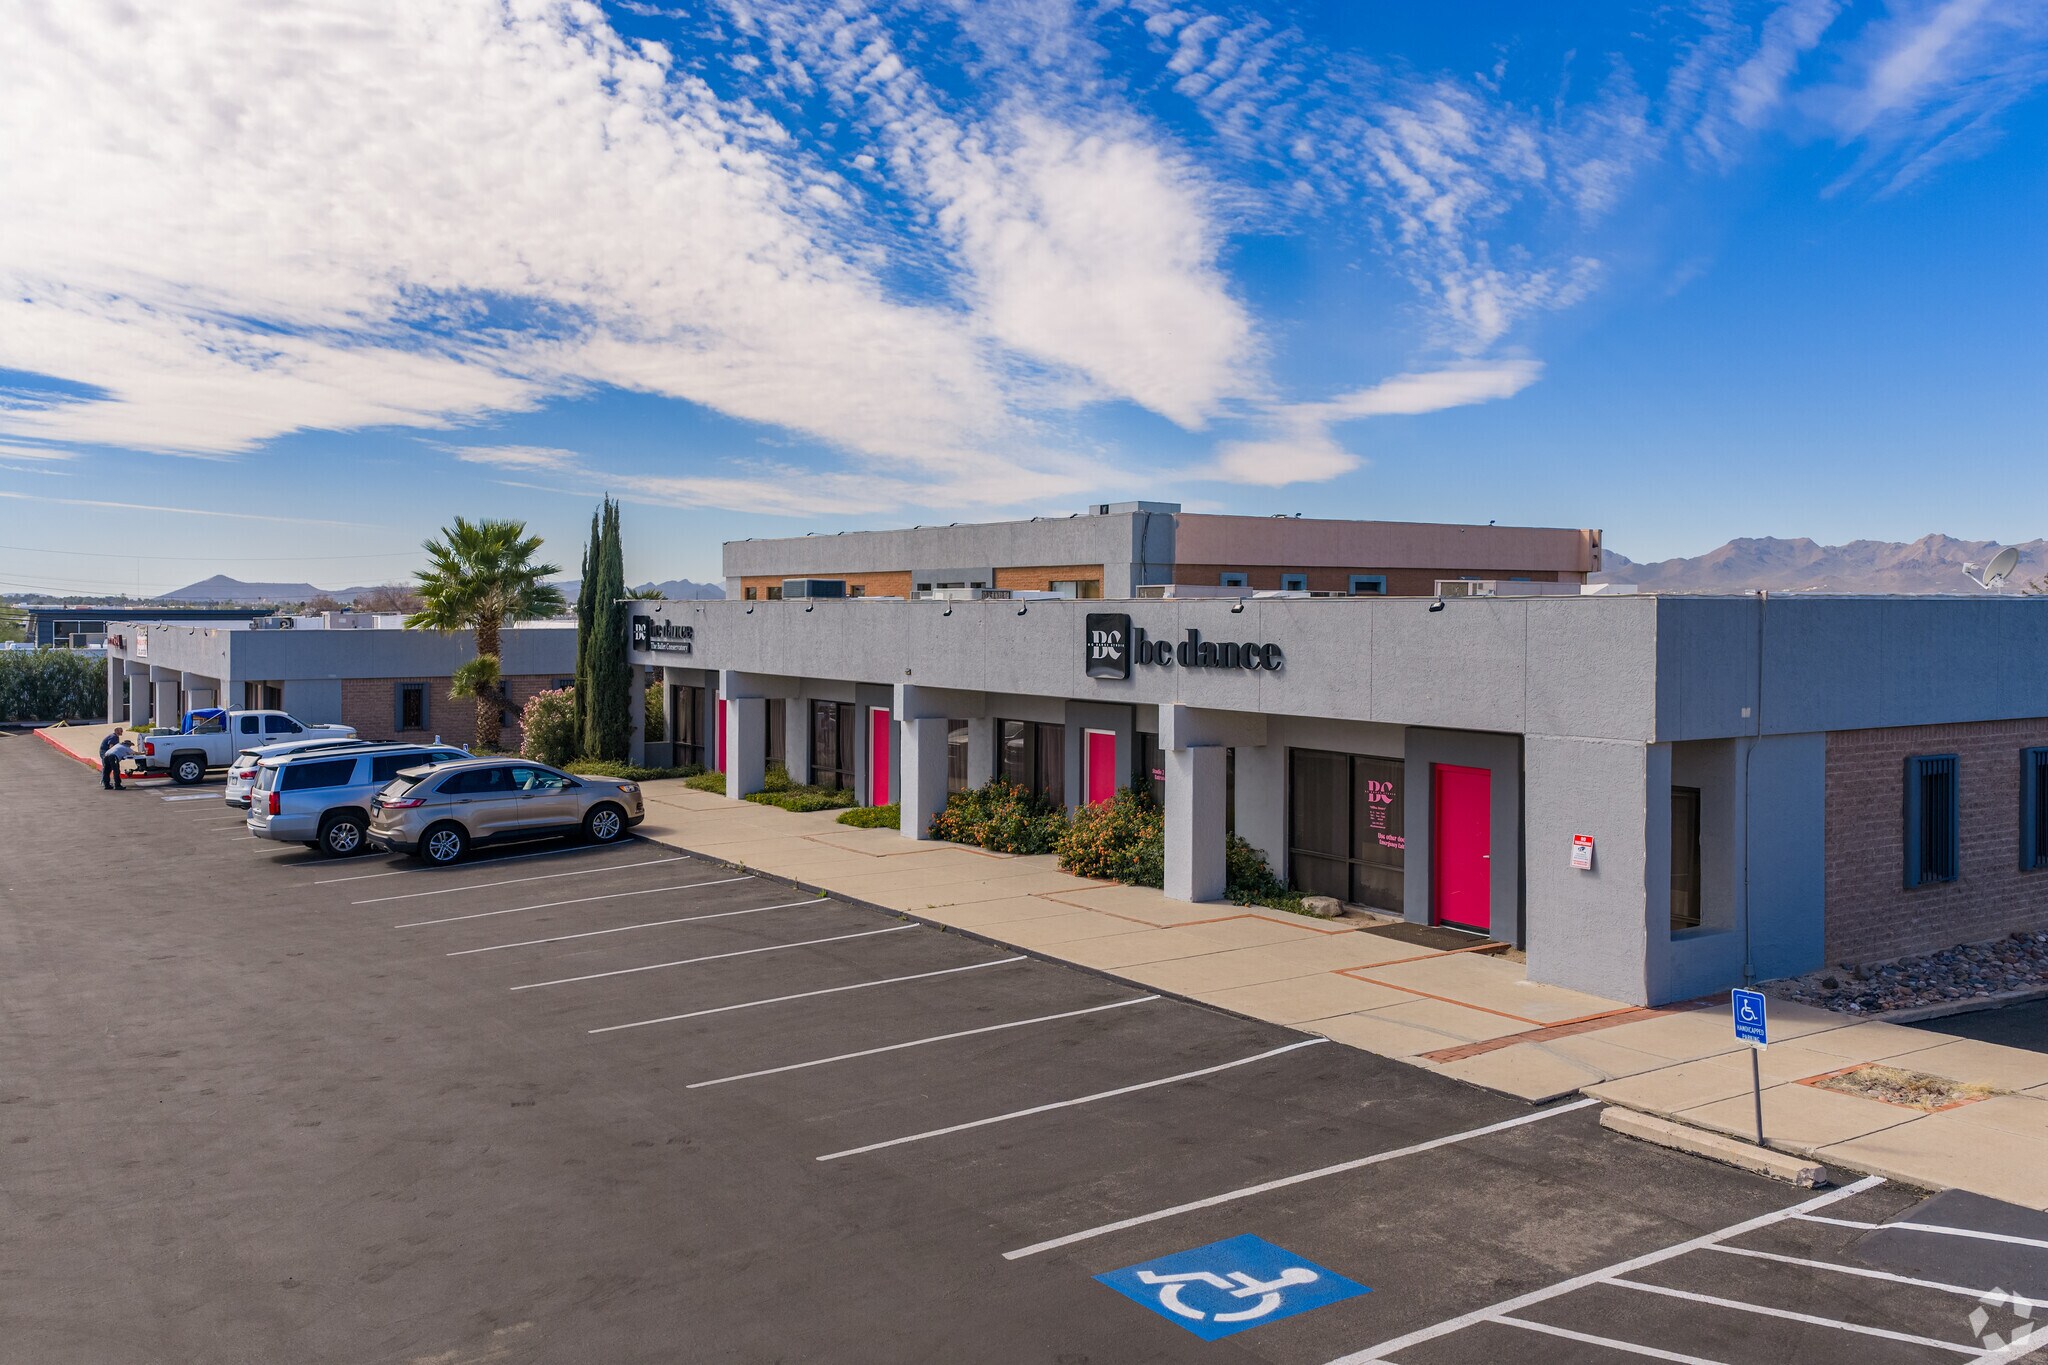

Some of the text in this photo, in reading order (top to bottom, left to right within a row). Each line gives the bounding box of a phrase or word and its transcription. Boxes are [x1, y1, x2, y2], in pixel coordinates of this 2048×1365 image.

[663, 619, 694, 639] dance
[1092, 630, 1122, 660] BC
[1132, 628, 1283, 671] bc dance
[1368, 780, 1393, 804] BC
